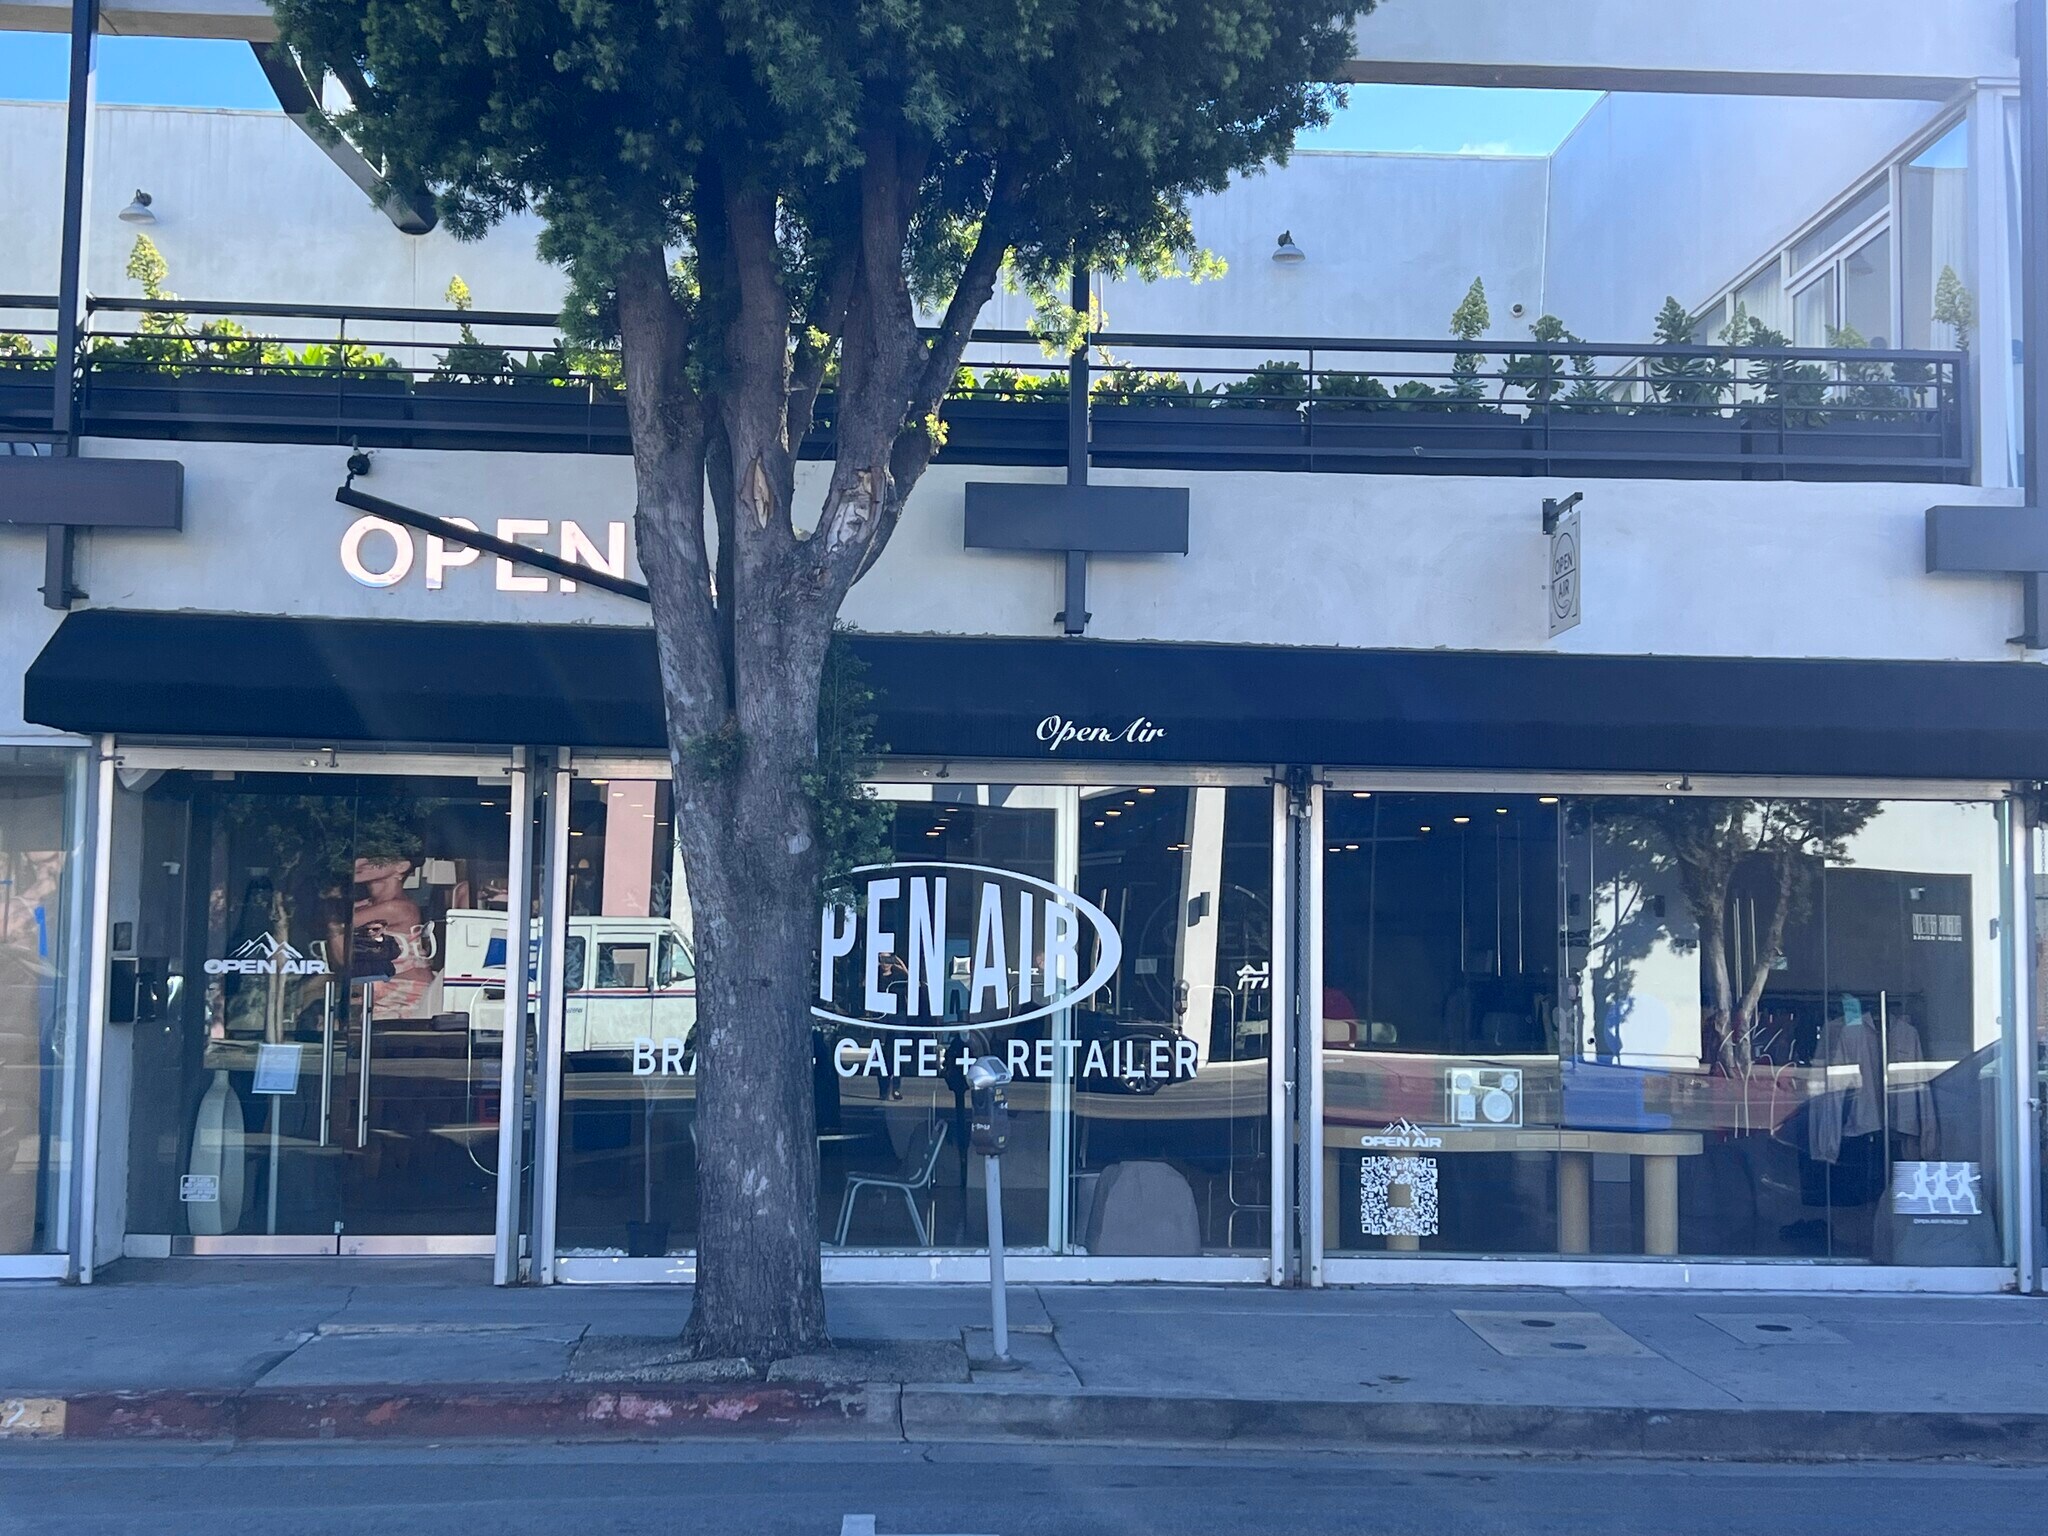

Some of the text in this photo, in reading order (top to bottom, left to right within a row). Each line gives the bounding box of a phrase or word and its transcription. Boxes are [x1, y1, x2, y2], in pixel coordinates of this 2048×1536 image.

[340, 515, 625, 593] OPEN
[1554, 553, 1573, 575] OPEN
[1558, 578, 1570, 599] AIR
[1036, 714, 1167, 751] Open Air
[819, 876, 1079, 1016] PEN AIR
[203, 958, 327, 975] OPEN AIR
[834, 1037, 938, 1078] CAFE
[1007, 1039, 1197, 1078] RETAILER
[1361, 1136, 1442, 1148] OPEN AIR
